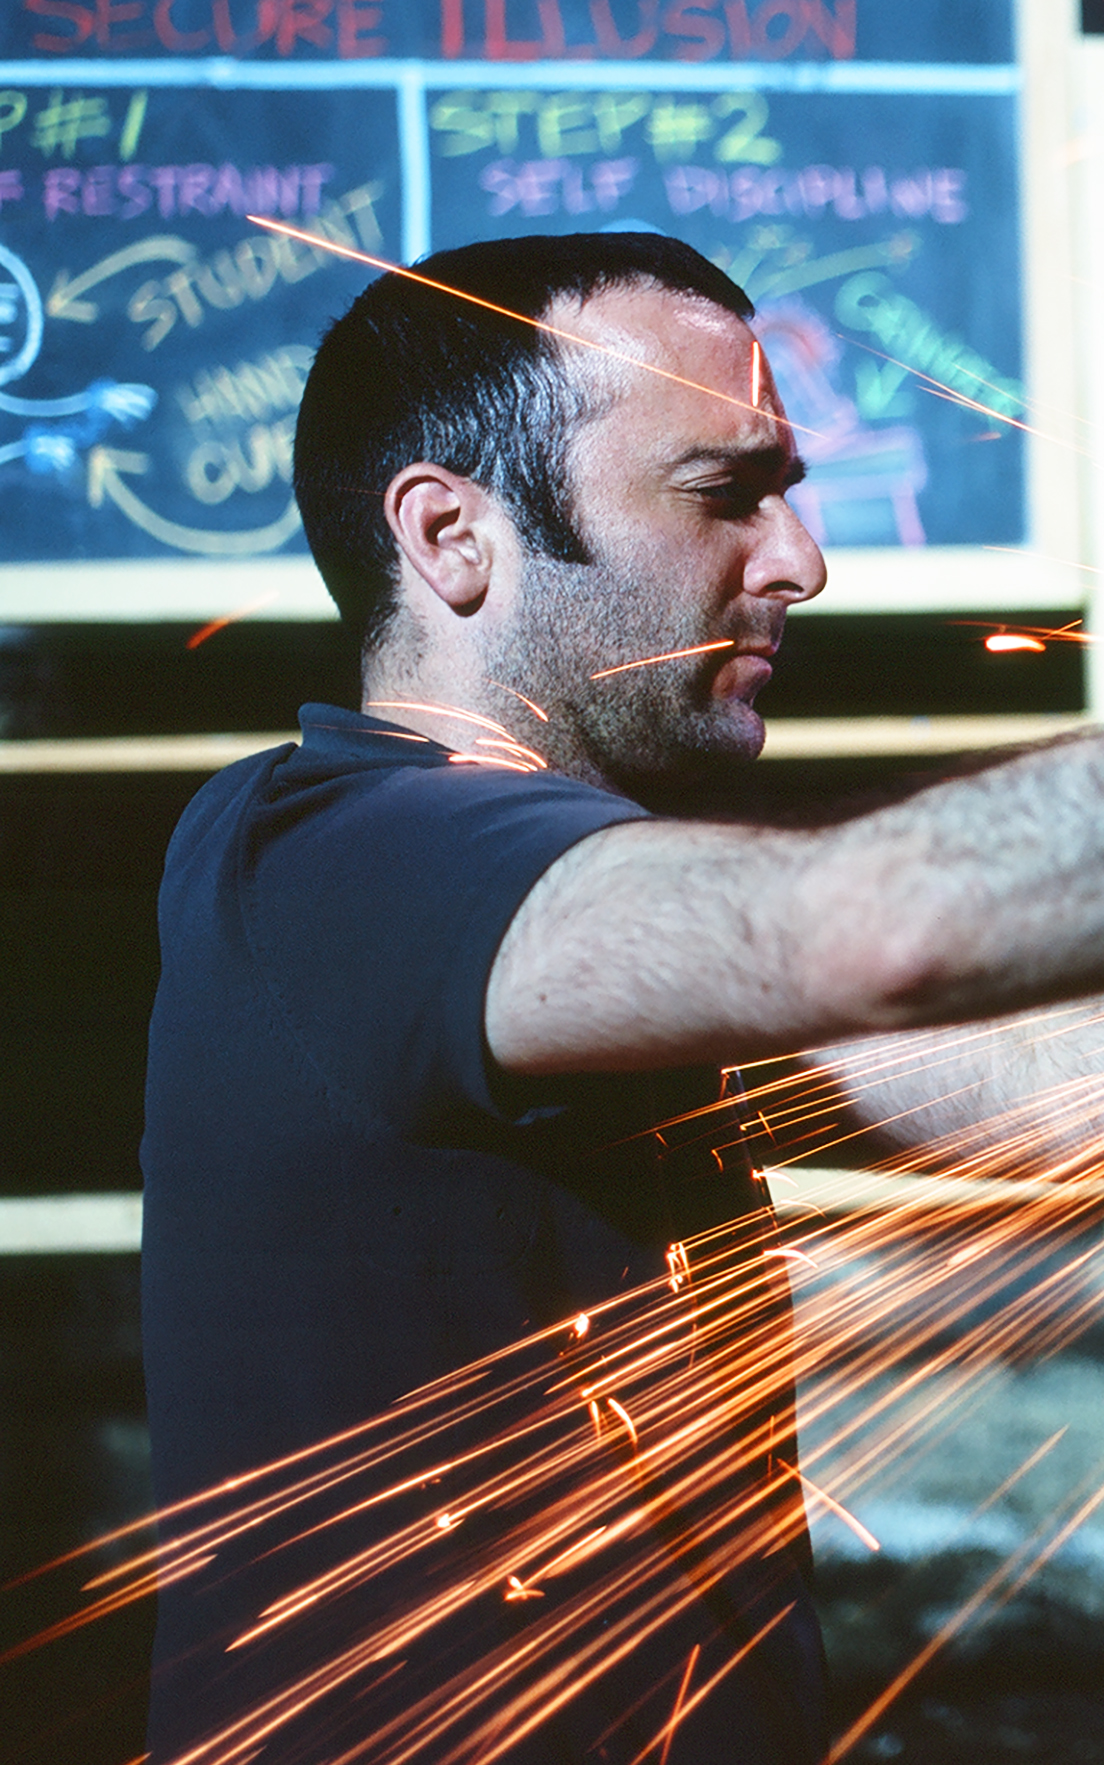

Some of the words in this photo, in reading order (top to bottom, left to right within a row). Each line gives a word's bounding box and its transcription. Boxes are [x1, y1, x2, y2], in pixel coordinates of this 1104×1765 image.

[25, 0, 392, 60] SECURE
[438, 0, 858, 61] ILLUSION
[42, 163, 337, 221] RESTRAINT
[479, 157, 641, 217] SELF
[662, 164, 969, 223] DISCIPLINE
[127, 181, 386, 352] STUDENT
